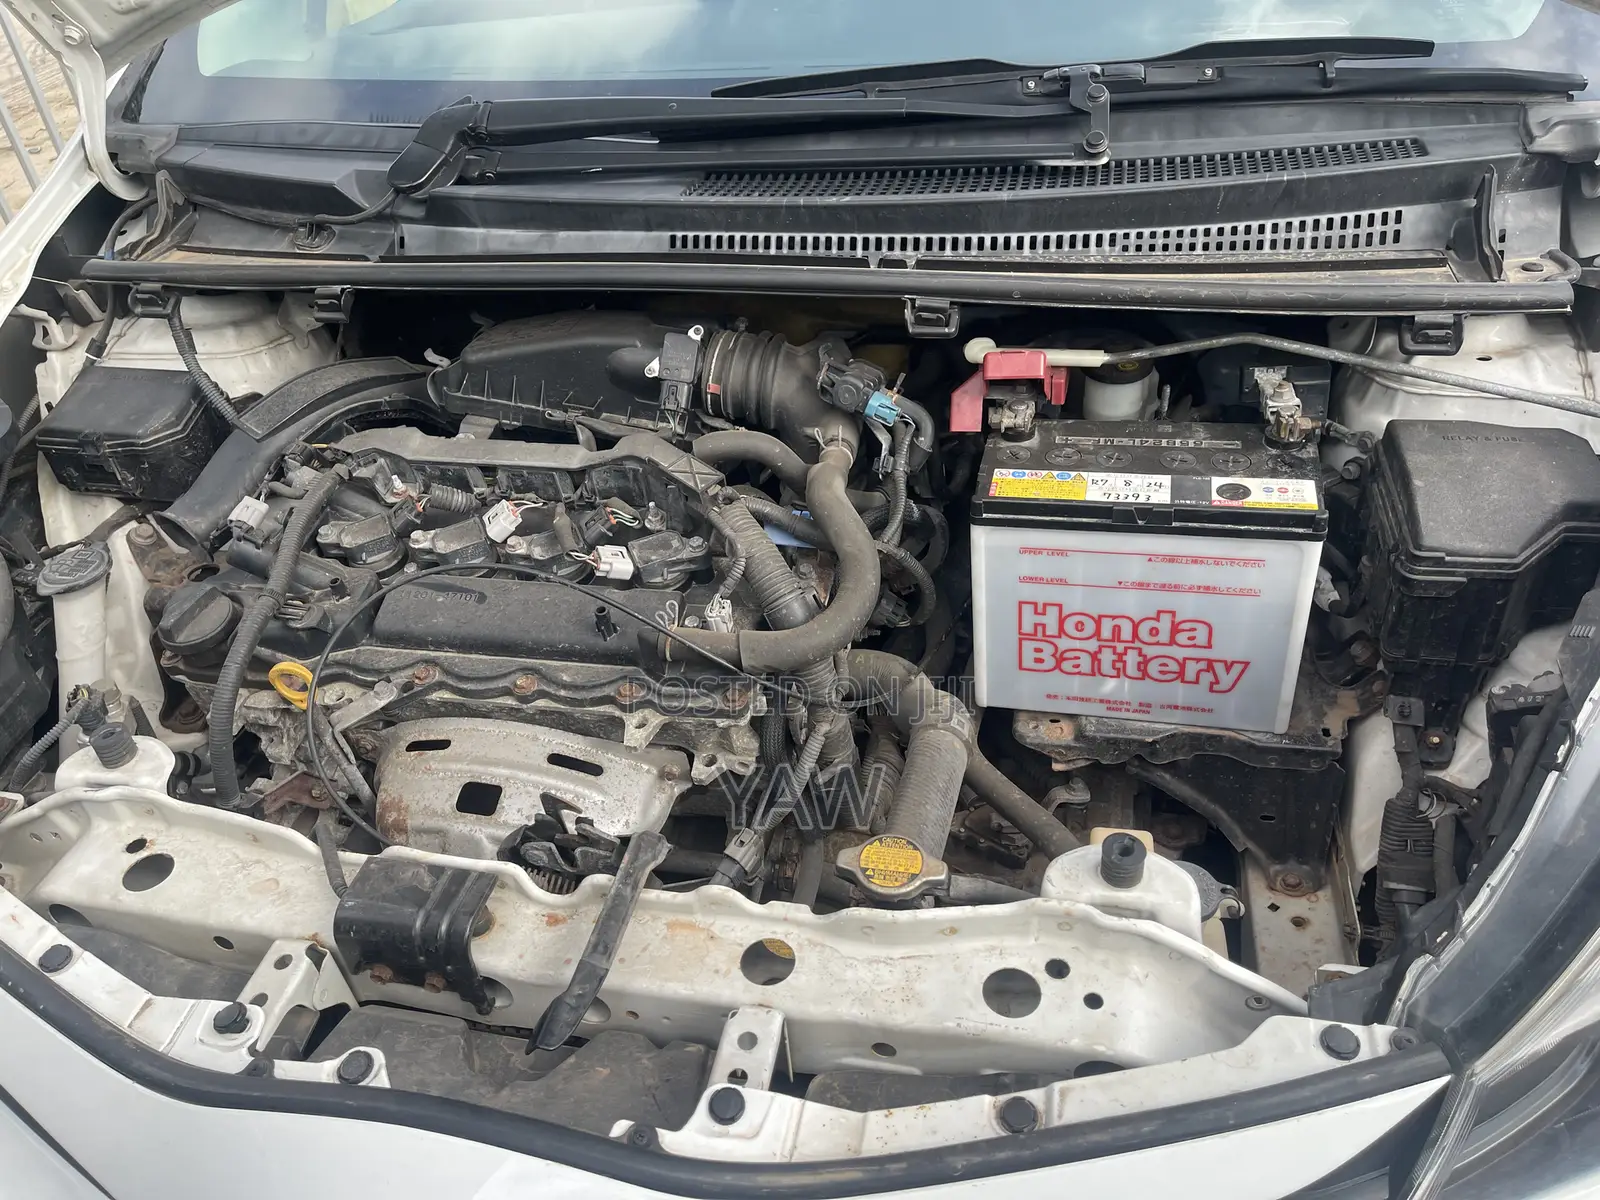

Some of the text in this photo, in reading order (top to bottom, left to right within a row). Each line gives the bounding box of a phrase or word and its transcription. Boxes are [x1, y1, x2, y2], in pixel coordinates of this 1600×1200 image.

[1018, 601, 1213, 649] Honda
[1018, 637, 1251, 693] Battery
[881, 836, 907, 844] CAUTION
